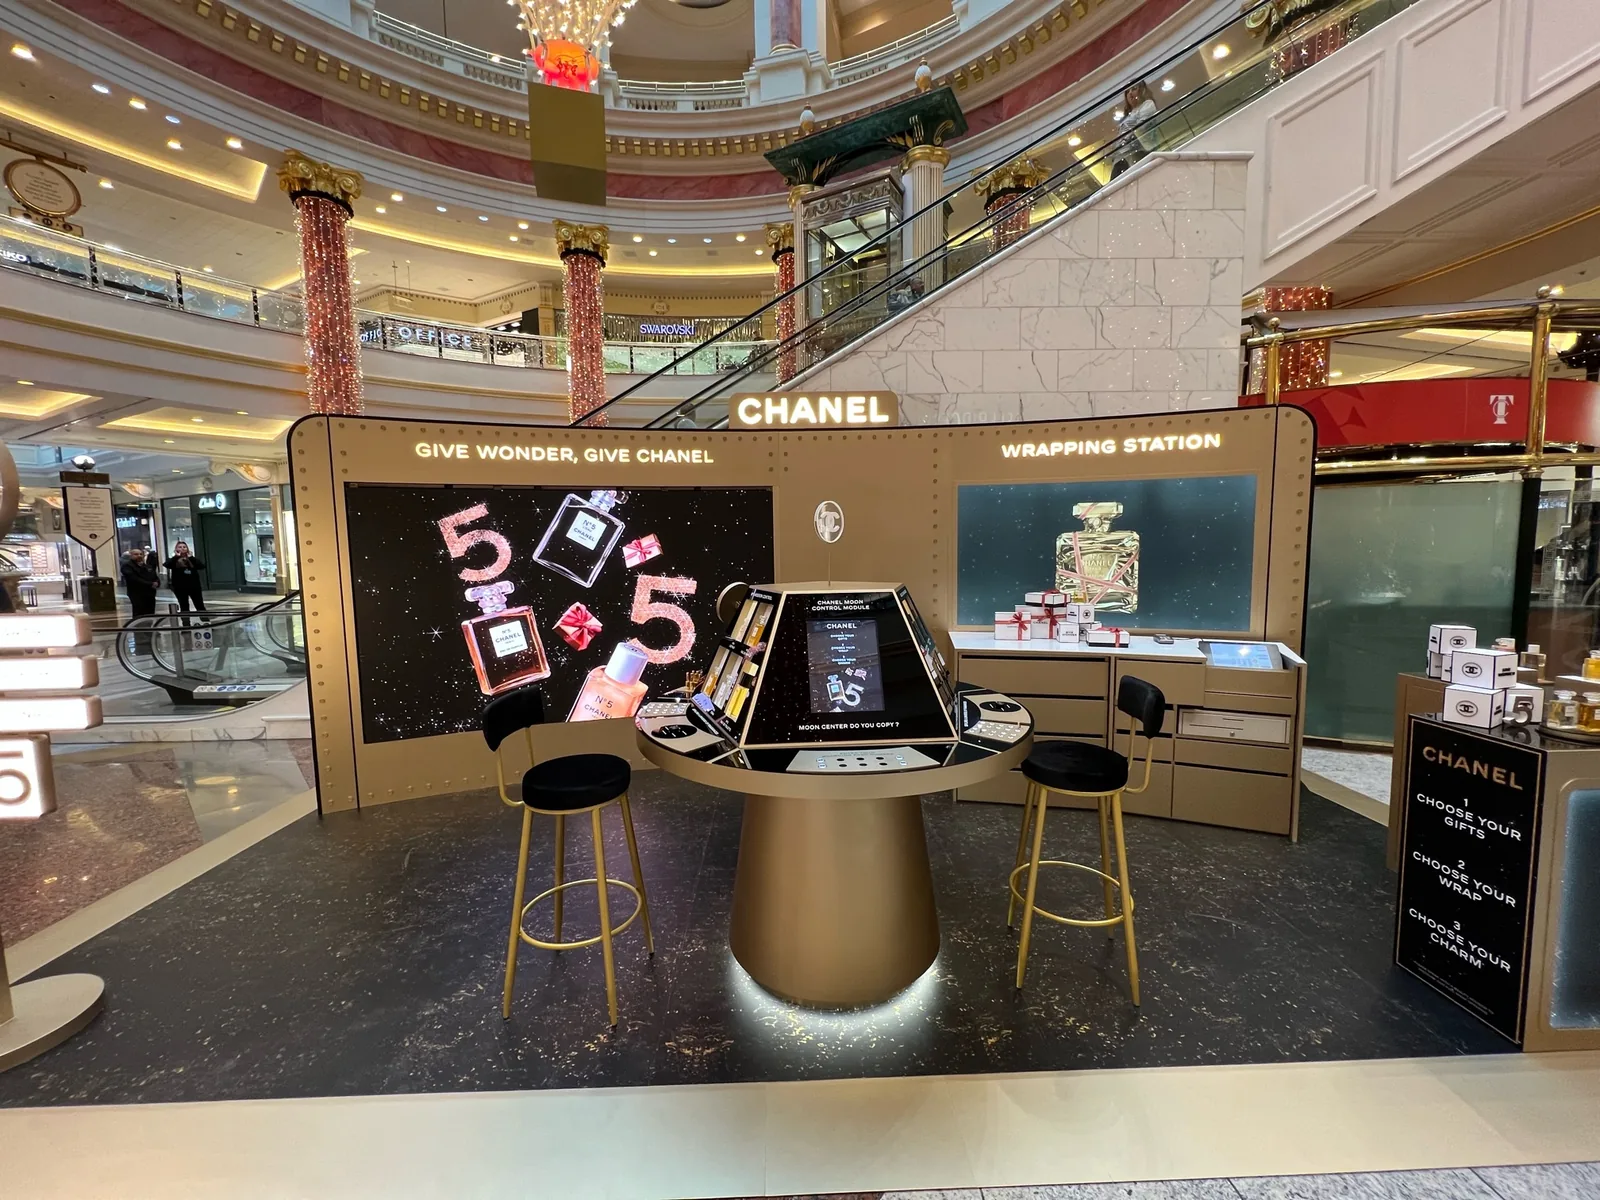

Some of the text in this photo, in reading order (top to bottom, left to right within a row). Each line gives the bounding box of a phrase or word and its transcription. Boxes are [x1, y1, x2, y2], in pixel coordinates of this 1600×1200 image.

[360, 328, 383, 342] OFFIC
[398, 326, 472, 348] OFFICE
[640, 324, 695, 335] SWAROVSKI
[738, 396, 890, 425] CHANEL
[415, 442, 714, 465] GIVE WONDER, GIVE CHANEL
[1001, 433, 1221, 458] WRAPPING STATION
[438, 503, 511, 581] 5
[573, 527, 595, 541] CHANEL
[631, 575, 697, 664] 5
[495, 632, 521, 643] CHANEL
[843, 682, 865, 706] 5
[584, 704, 613, 720] CHANE
[1422, 746, 1523, 790] CHANEL
[1463, 798, 1468, 807] 1
[1416, 793, 1521, 841] CHOOSE YOUR
[1444, 816, 1485, 839] GIFTS
[1457, 860, 1465, 870] 2
[1412, 851, 1516, 908] CHOOSE YOUR
[1439, 874, 1482, 901] WRAP
[1453, 920, 1461, 931] 3
[1409, 908, 1511, 973] CHOOSE YOUR
